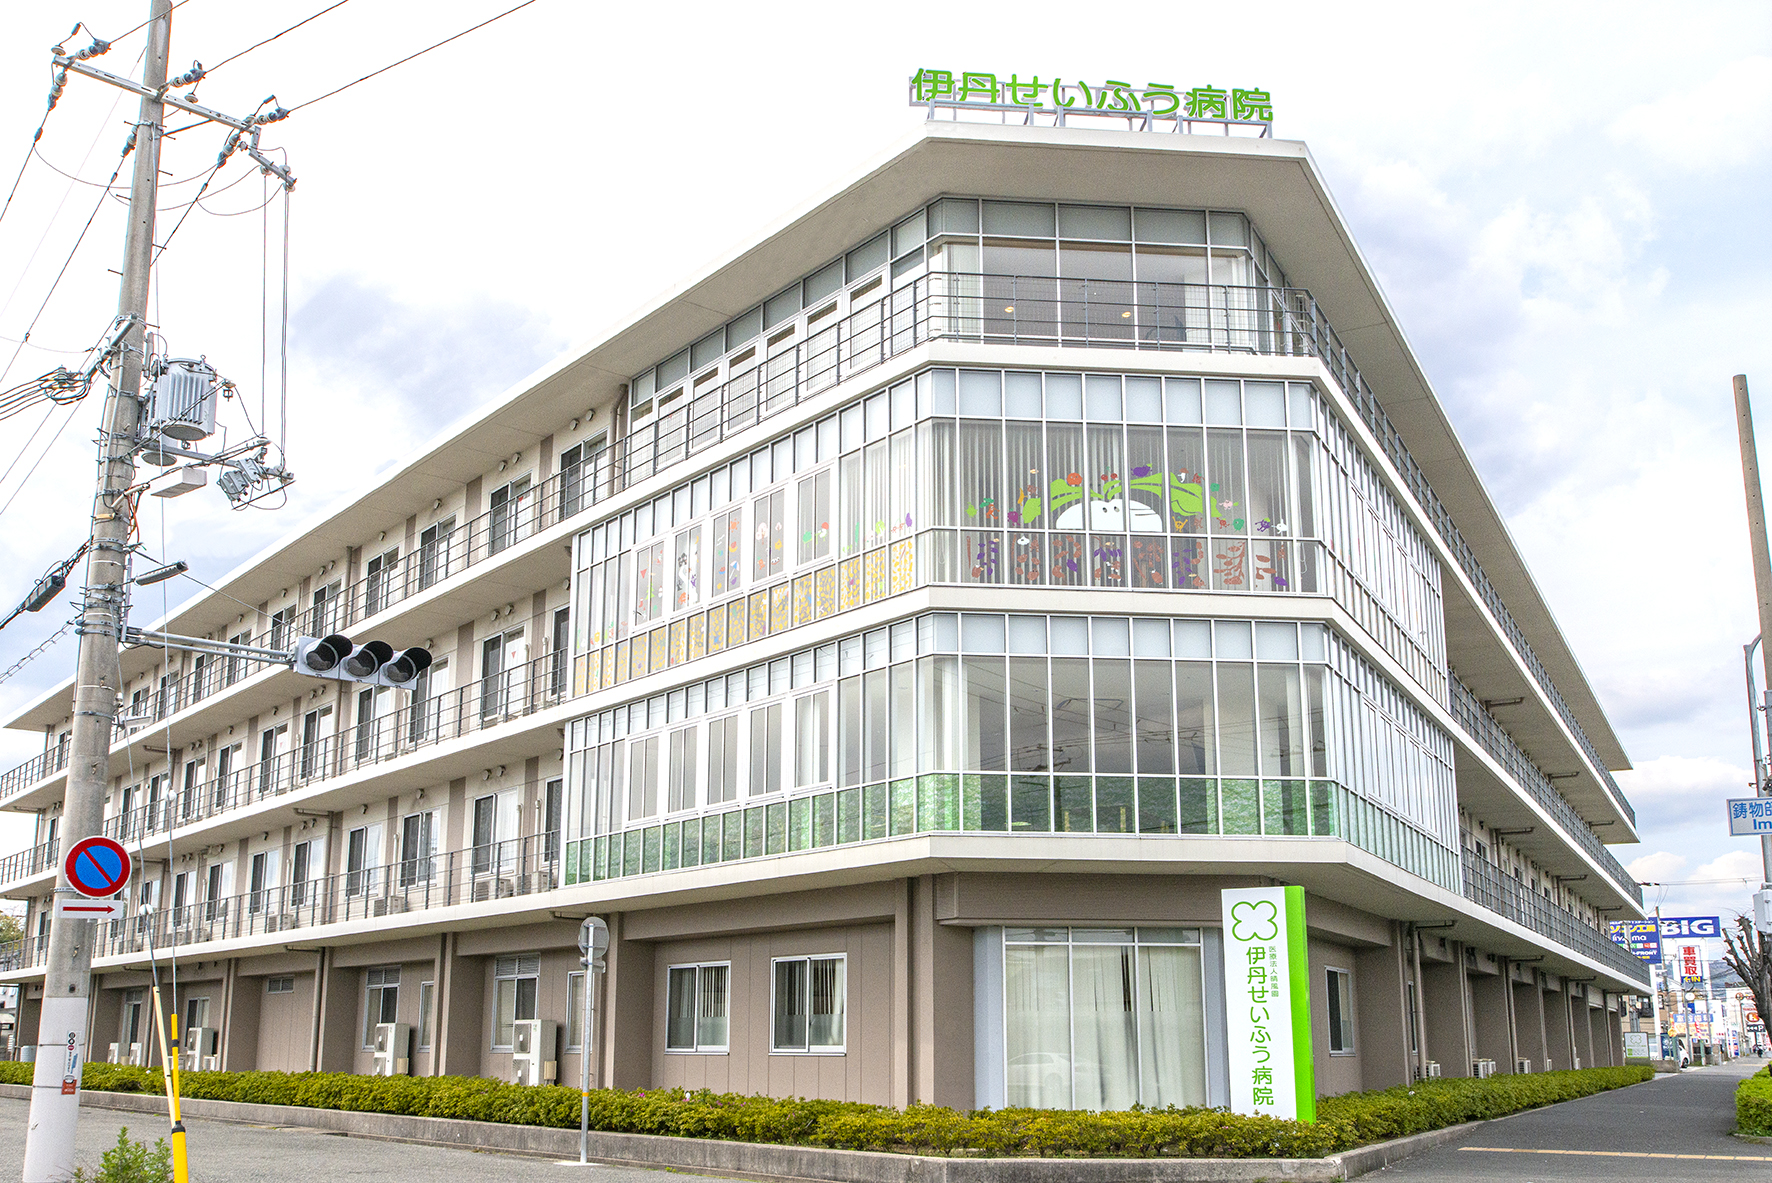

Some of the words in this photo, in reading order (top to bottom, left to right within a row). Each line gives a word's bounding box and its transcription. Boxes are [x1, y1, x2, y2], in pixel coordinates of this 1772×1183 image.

[910, 67, 1274, 122] 伊丹せいふう病院
[1660, 919, 1714, 936] BIG
[1682, 946, 1698, 975] 車買取
[1245, 946, 1275, 1106] 伊丹せいふう病院
